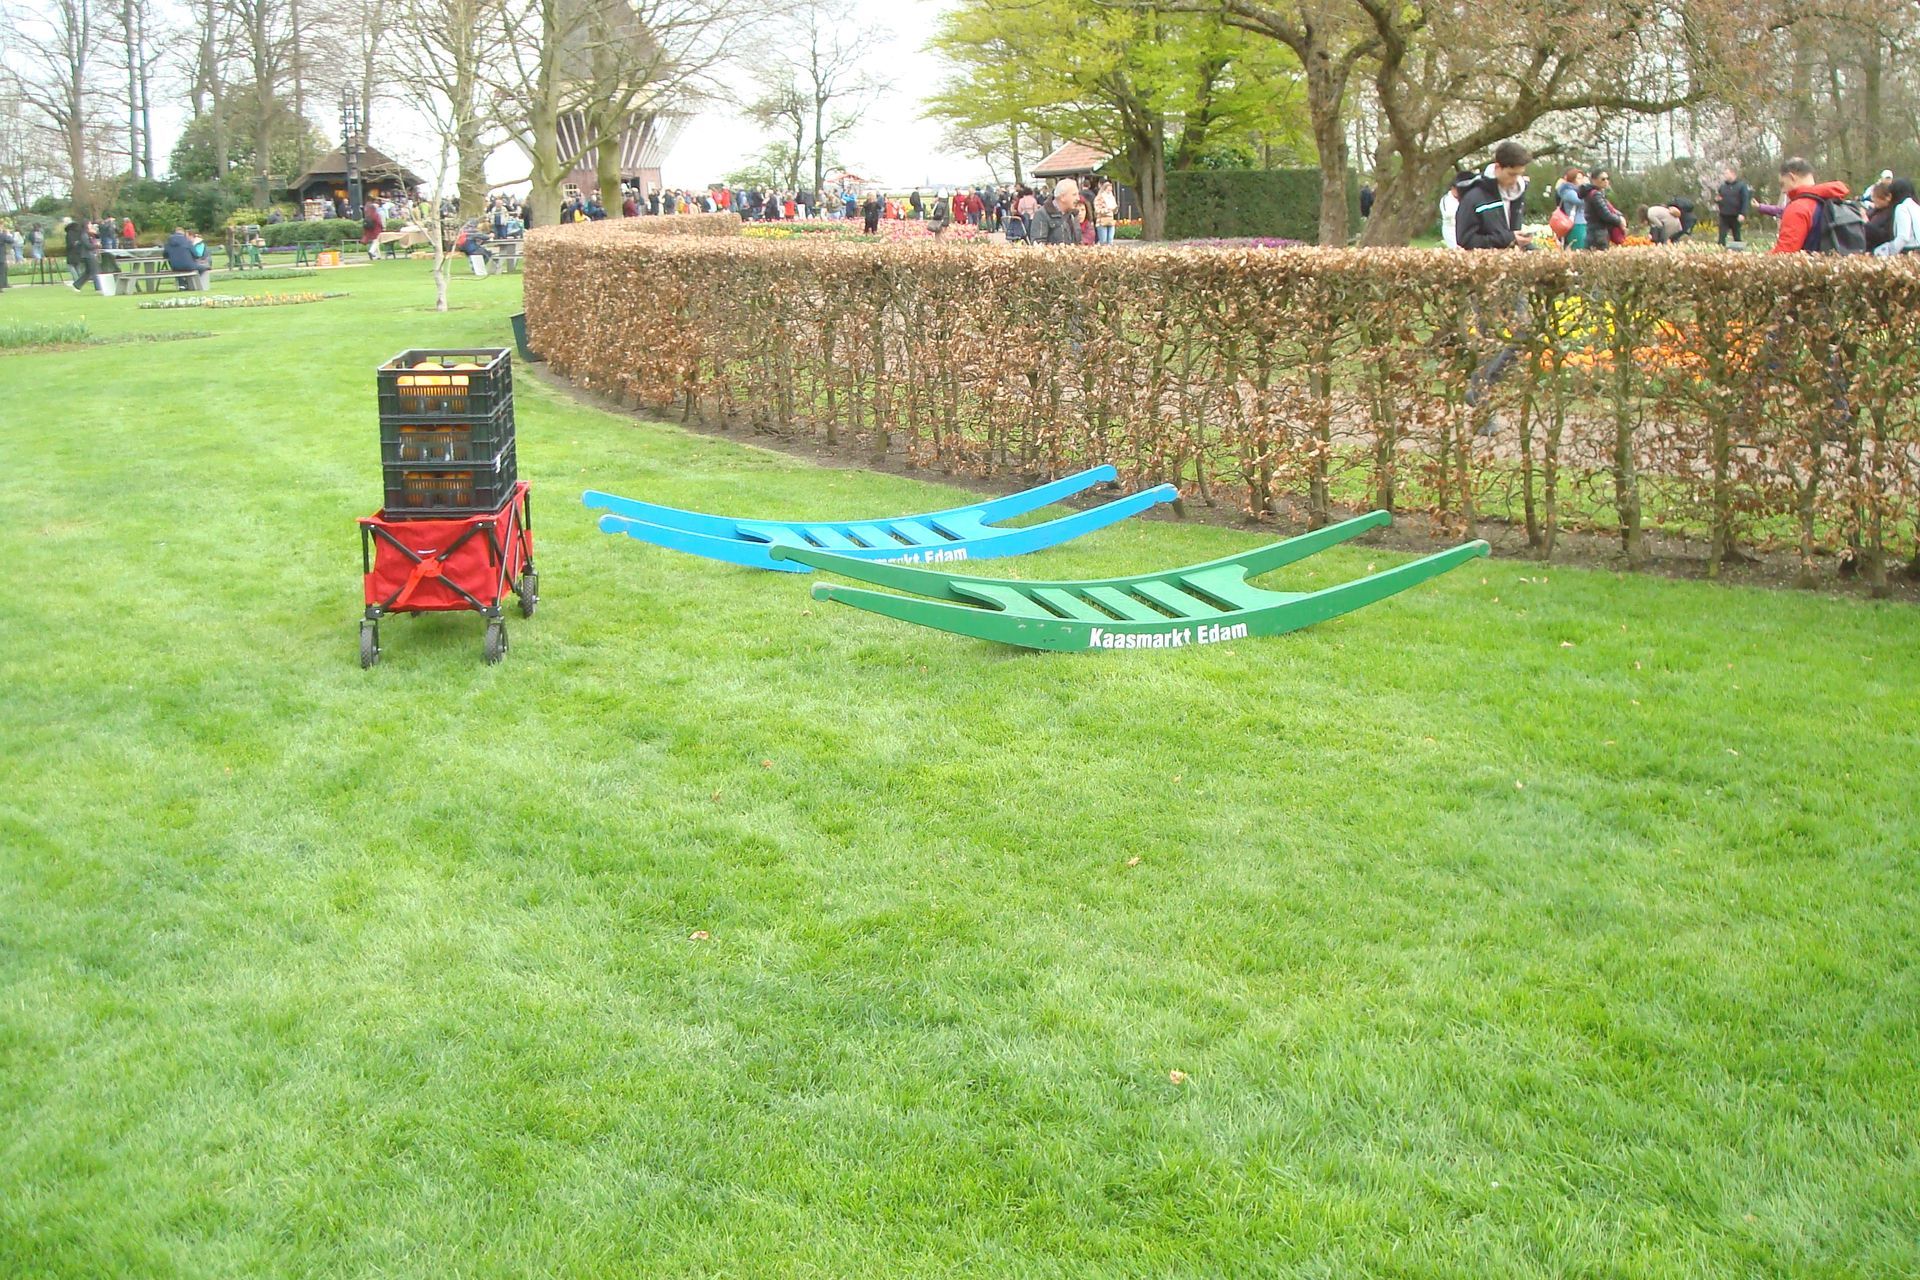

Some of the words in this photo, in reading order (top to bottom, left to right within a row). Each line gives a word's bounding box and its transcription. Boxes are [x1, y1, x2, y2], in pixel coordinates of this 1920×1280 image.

[924, 547, 967, 564] Edam
[1089, 627, 1192, 649] Kaasmarkt
[1196, 622, 1248, 644] Edam
